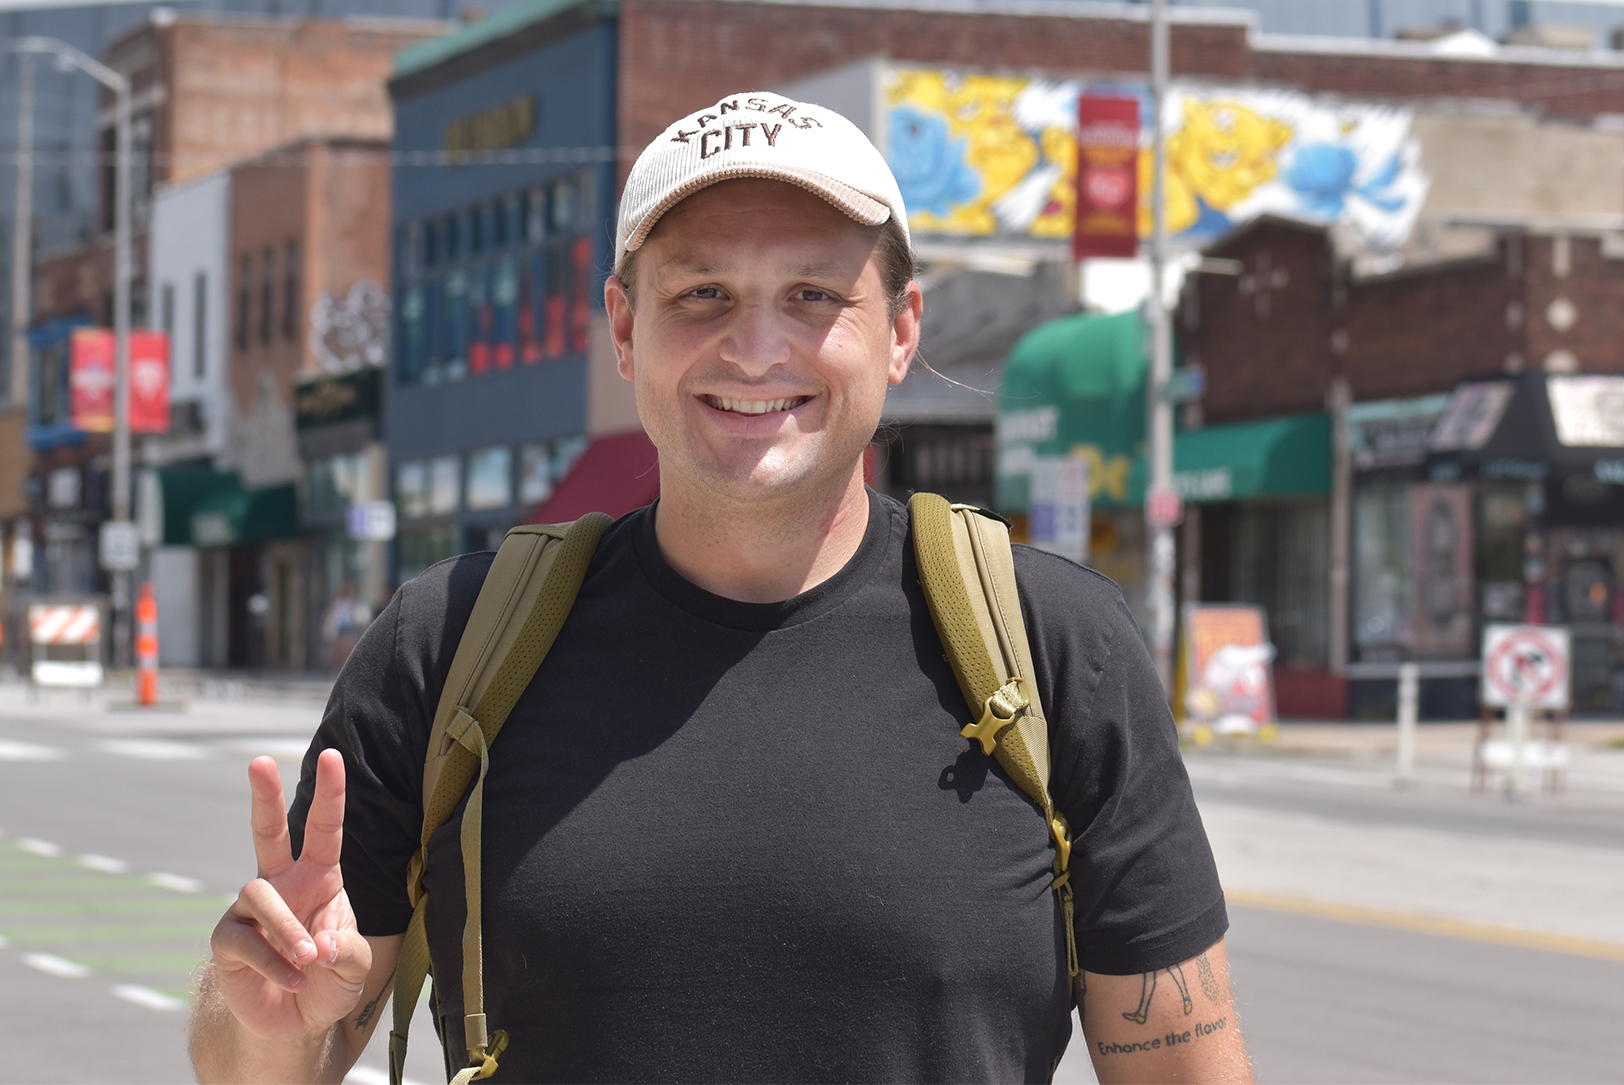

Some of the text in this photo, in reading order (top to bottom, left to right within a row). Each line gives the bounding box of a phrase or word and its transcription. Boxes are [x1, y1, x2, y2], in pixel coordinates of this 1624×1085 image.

[670, 98, 823, 143] KANSAS
[701, 123, 782, 159] CITY
[1097, 1017, 1228, 1056] Enhance the flavor
